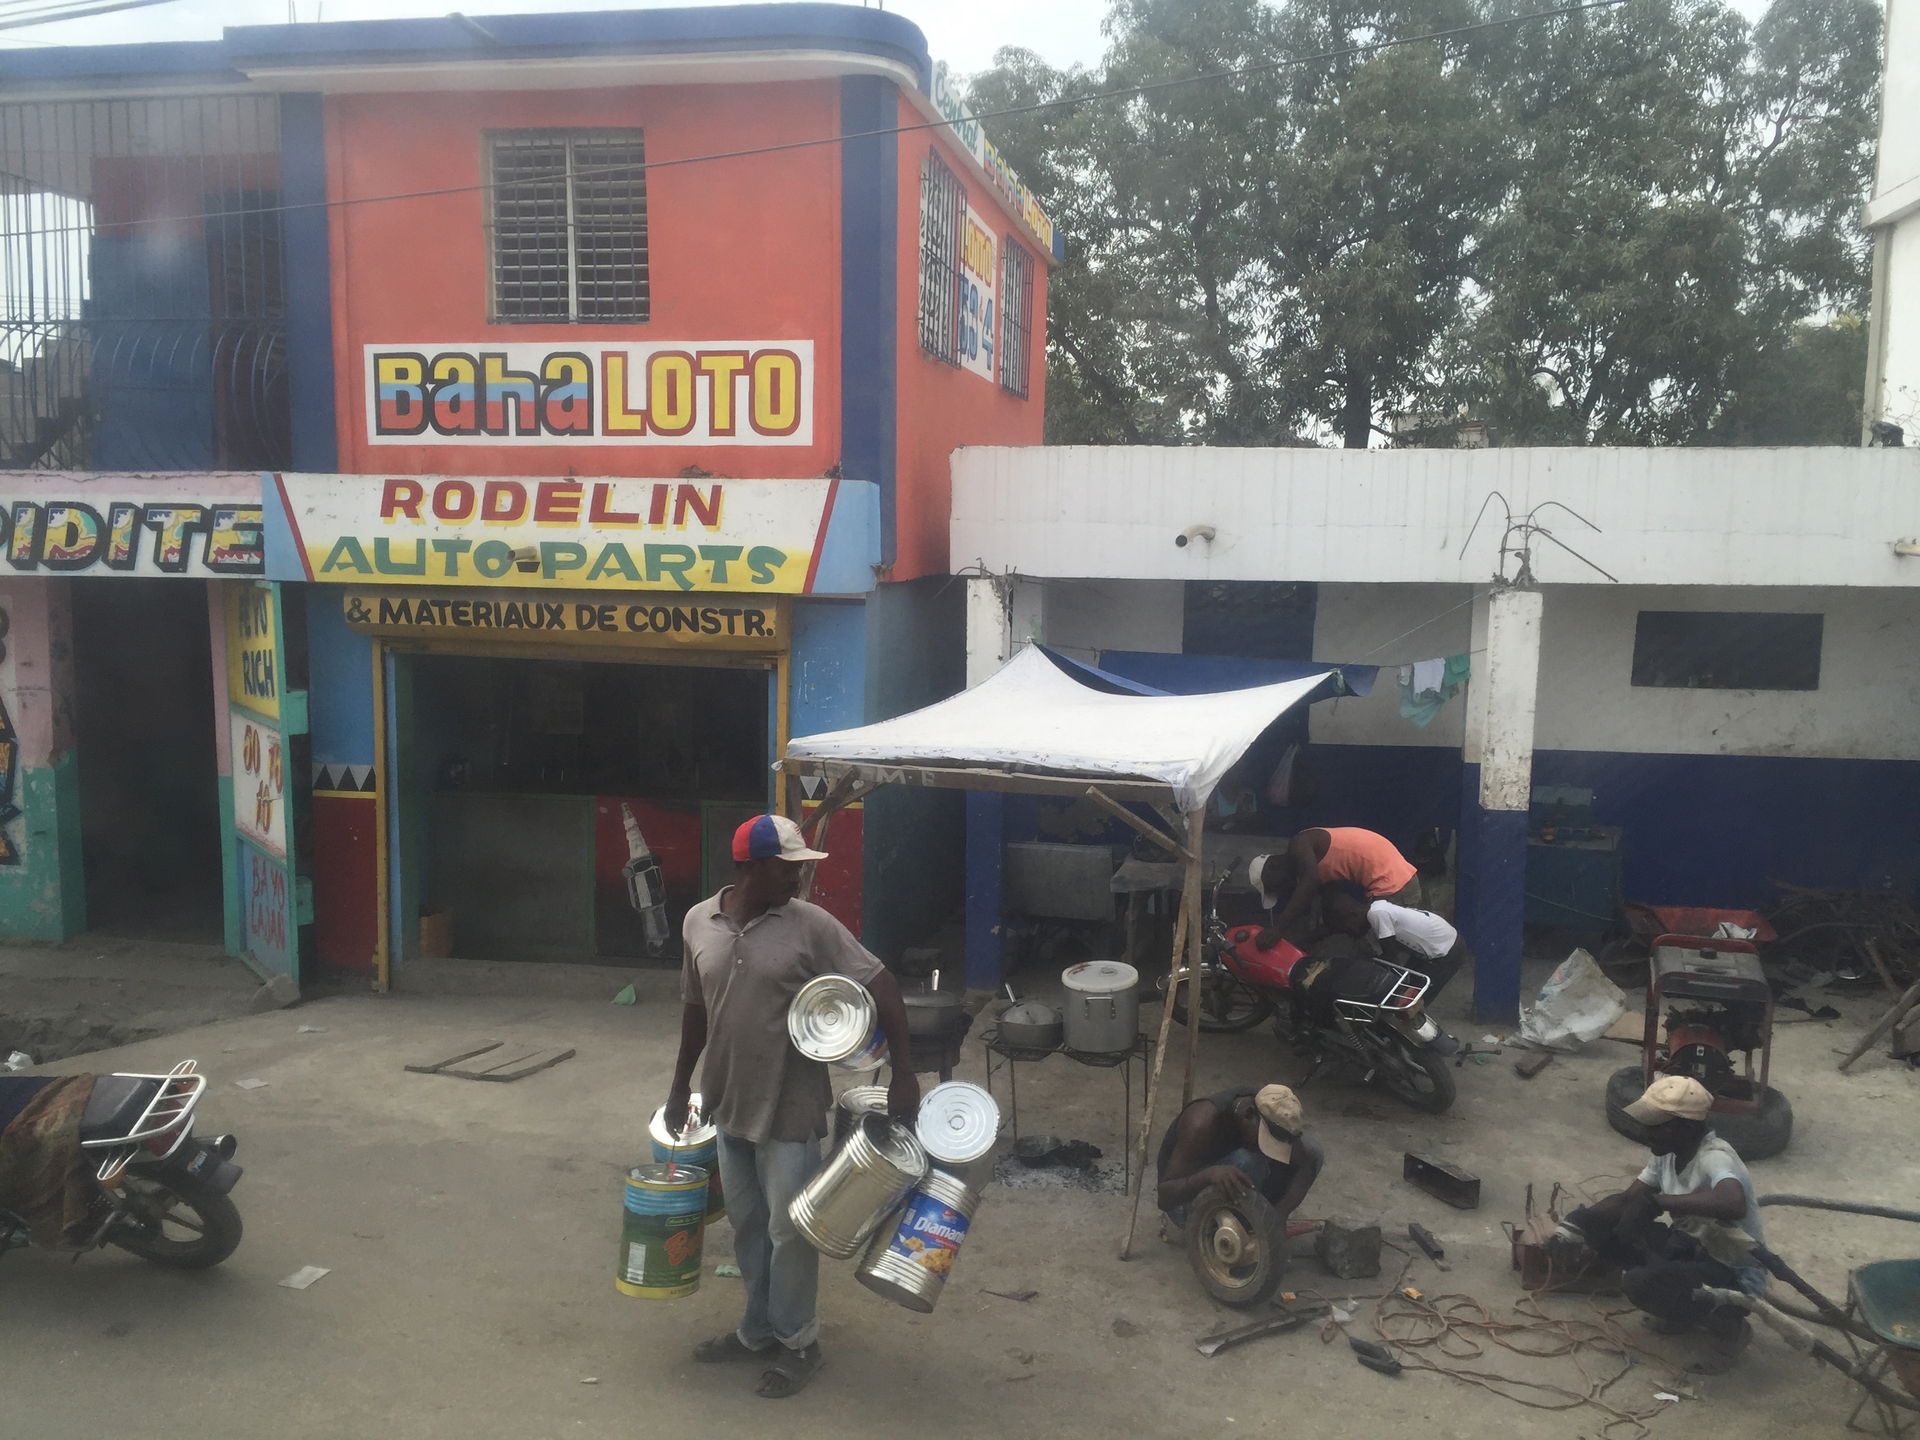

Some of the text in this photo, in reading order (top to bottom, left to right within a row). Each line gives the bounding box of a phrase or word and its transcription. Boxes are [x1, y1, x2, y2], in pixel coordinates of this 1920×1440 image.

[935, 71, 979, 155] Central
[379, 478, 724, 527] RODELIN
[0, 501, 264, 574] IDITE
[347, 598, 774, 636] & MATERIAUX DE CONSTR.
[242, 649, 275, 698] RICH
